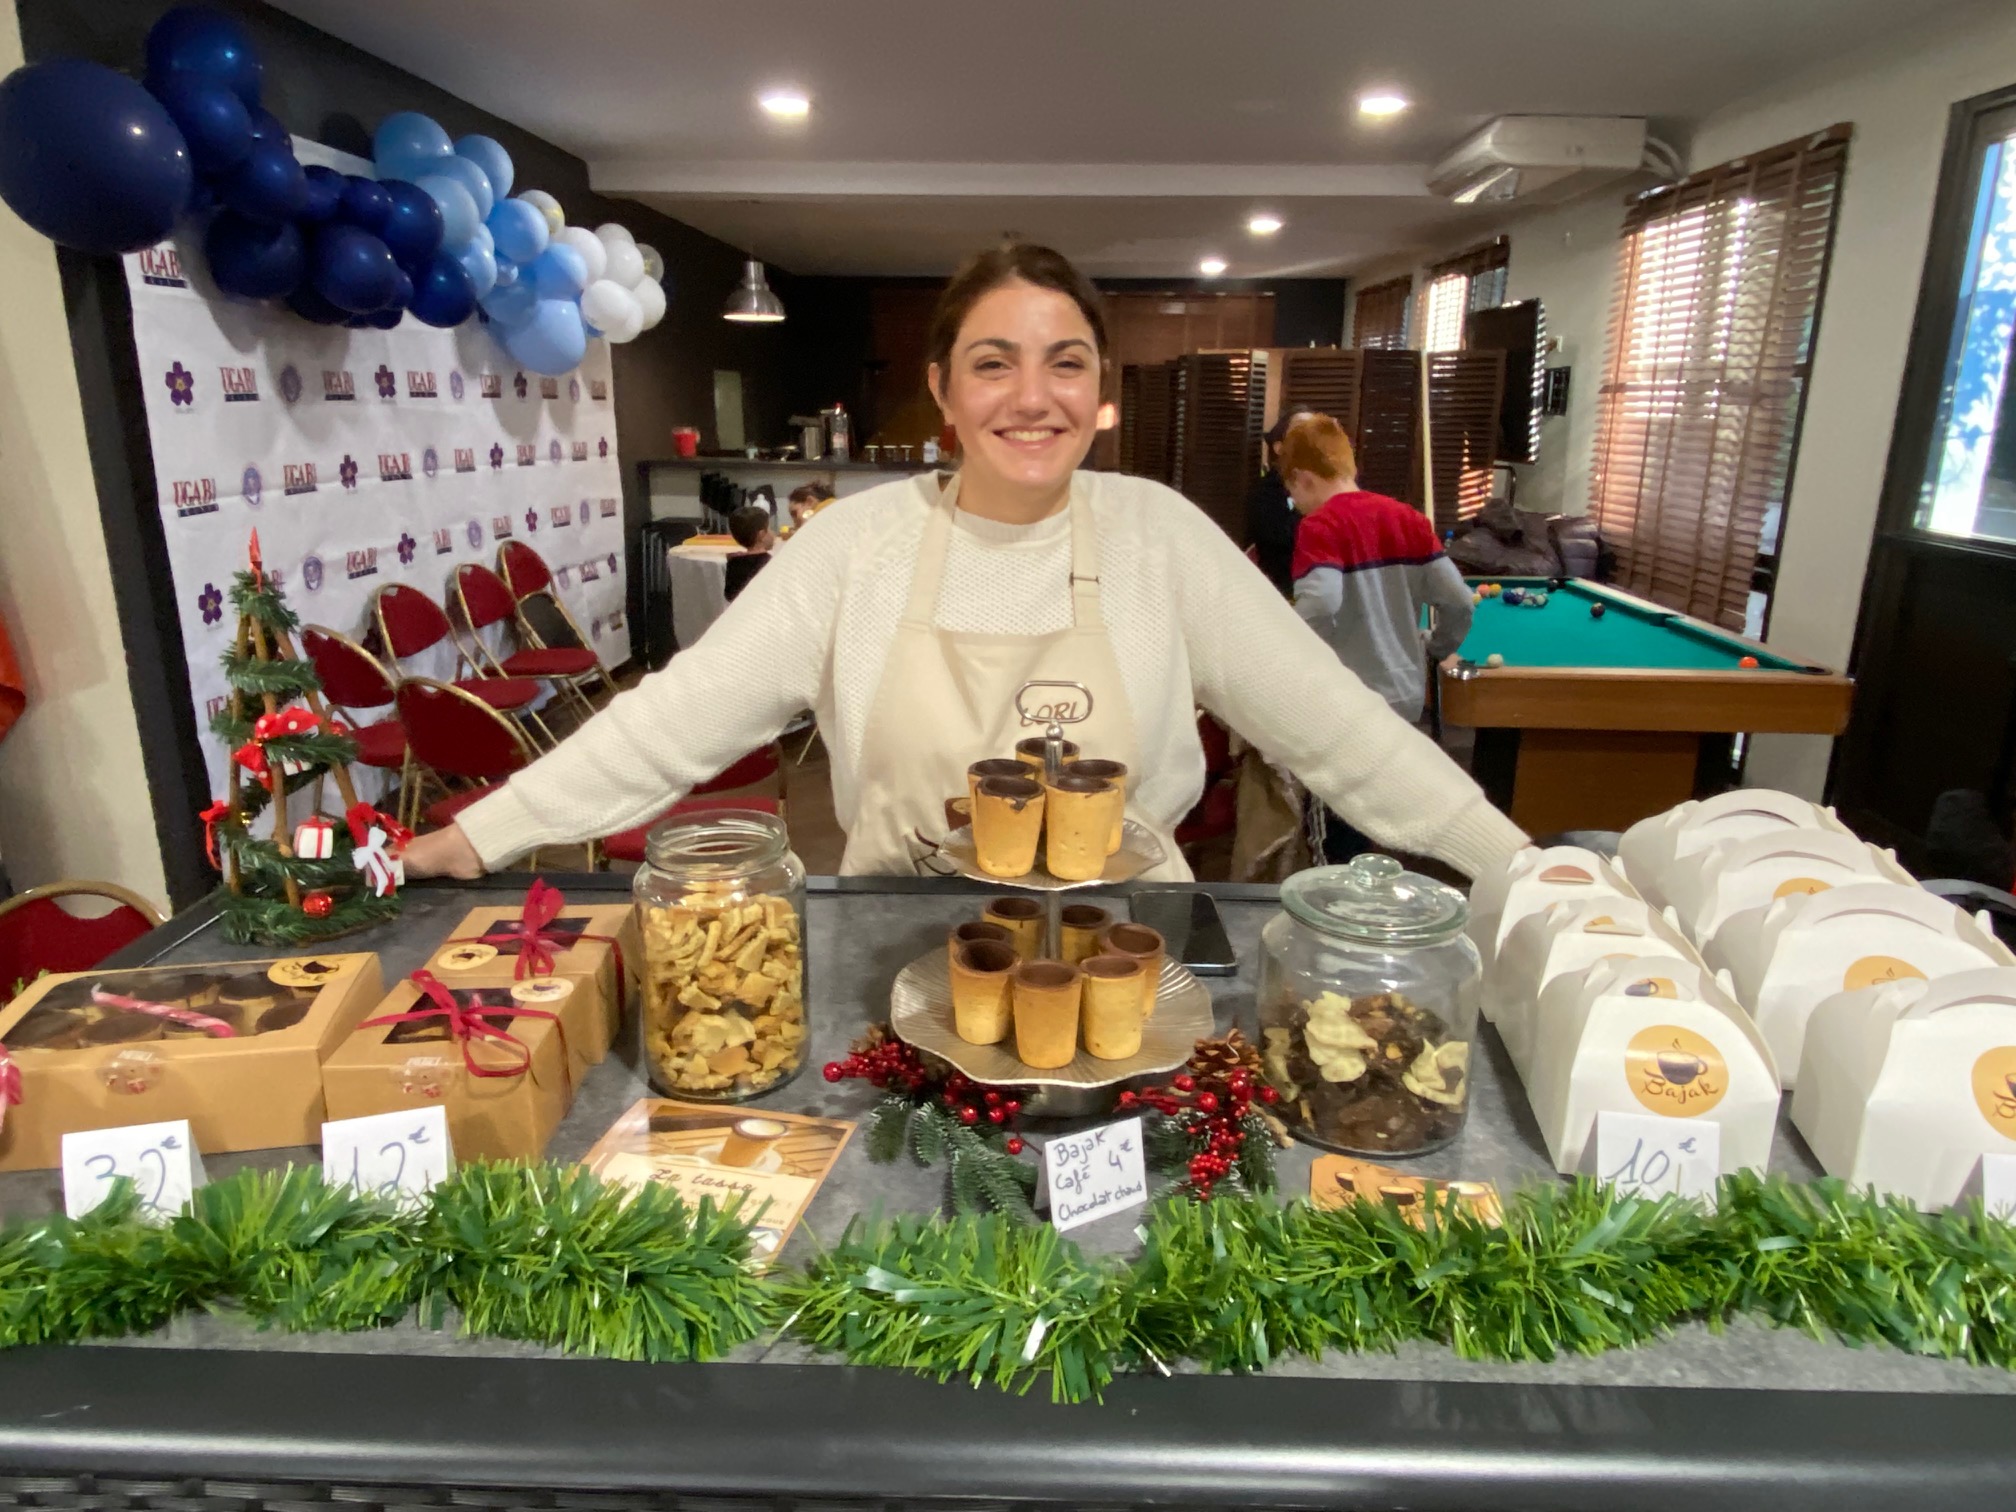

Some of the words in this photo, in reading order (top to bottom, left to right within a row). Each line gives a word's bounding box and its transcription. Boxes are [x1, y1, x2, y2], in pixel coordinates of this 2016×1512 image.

[1641, 1068, 1720, 1105] Bajak
[1053, 1126, 1111, 1167] Bajak
[1055, 1164, 1091, 1196] Café
